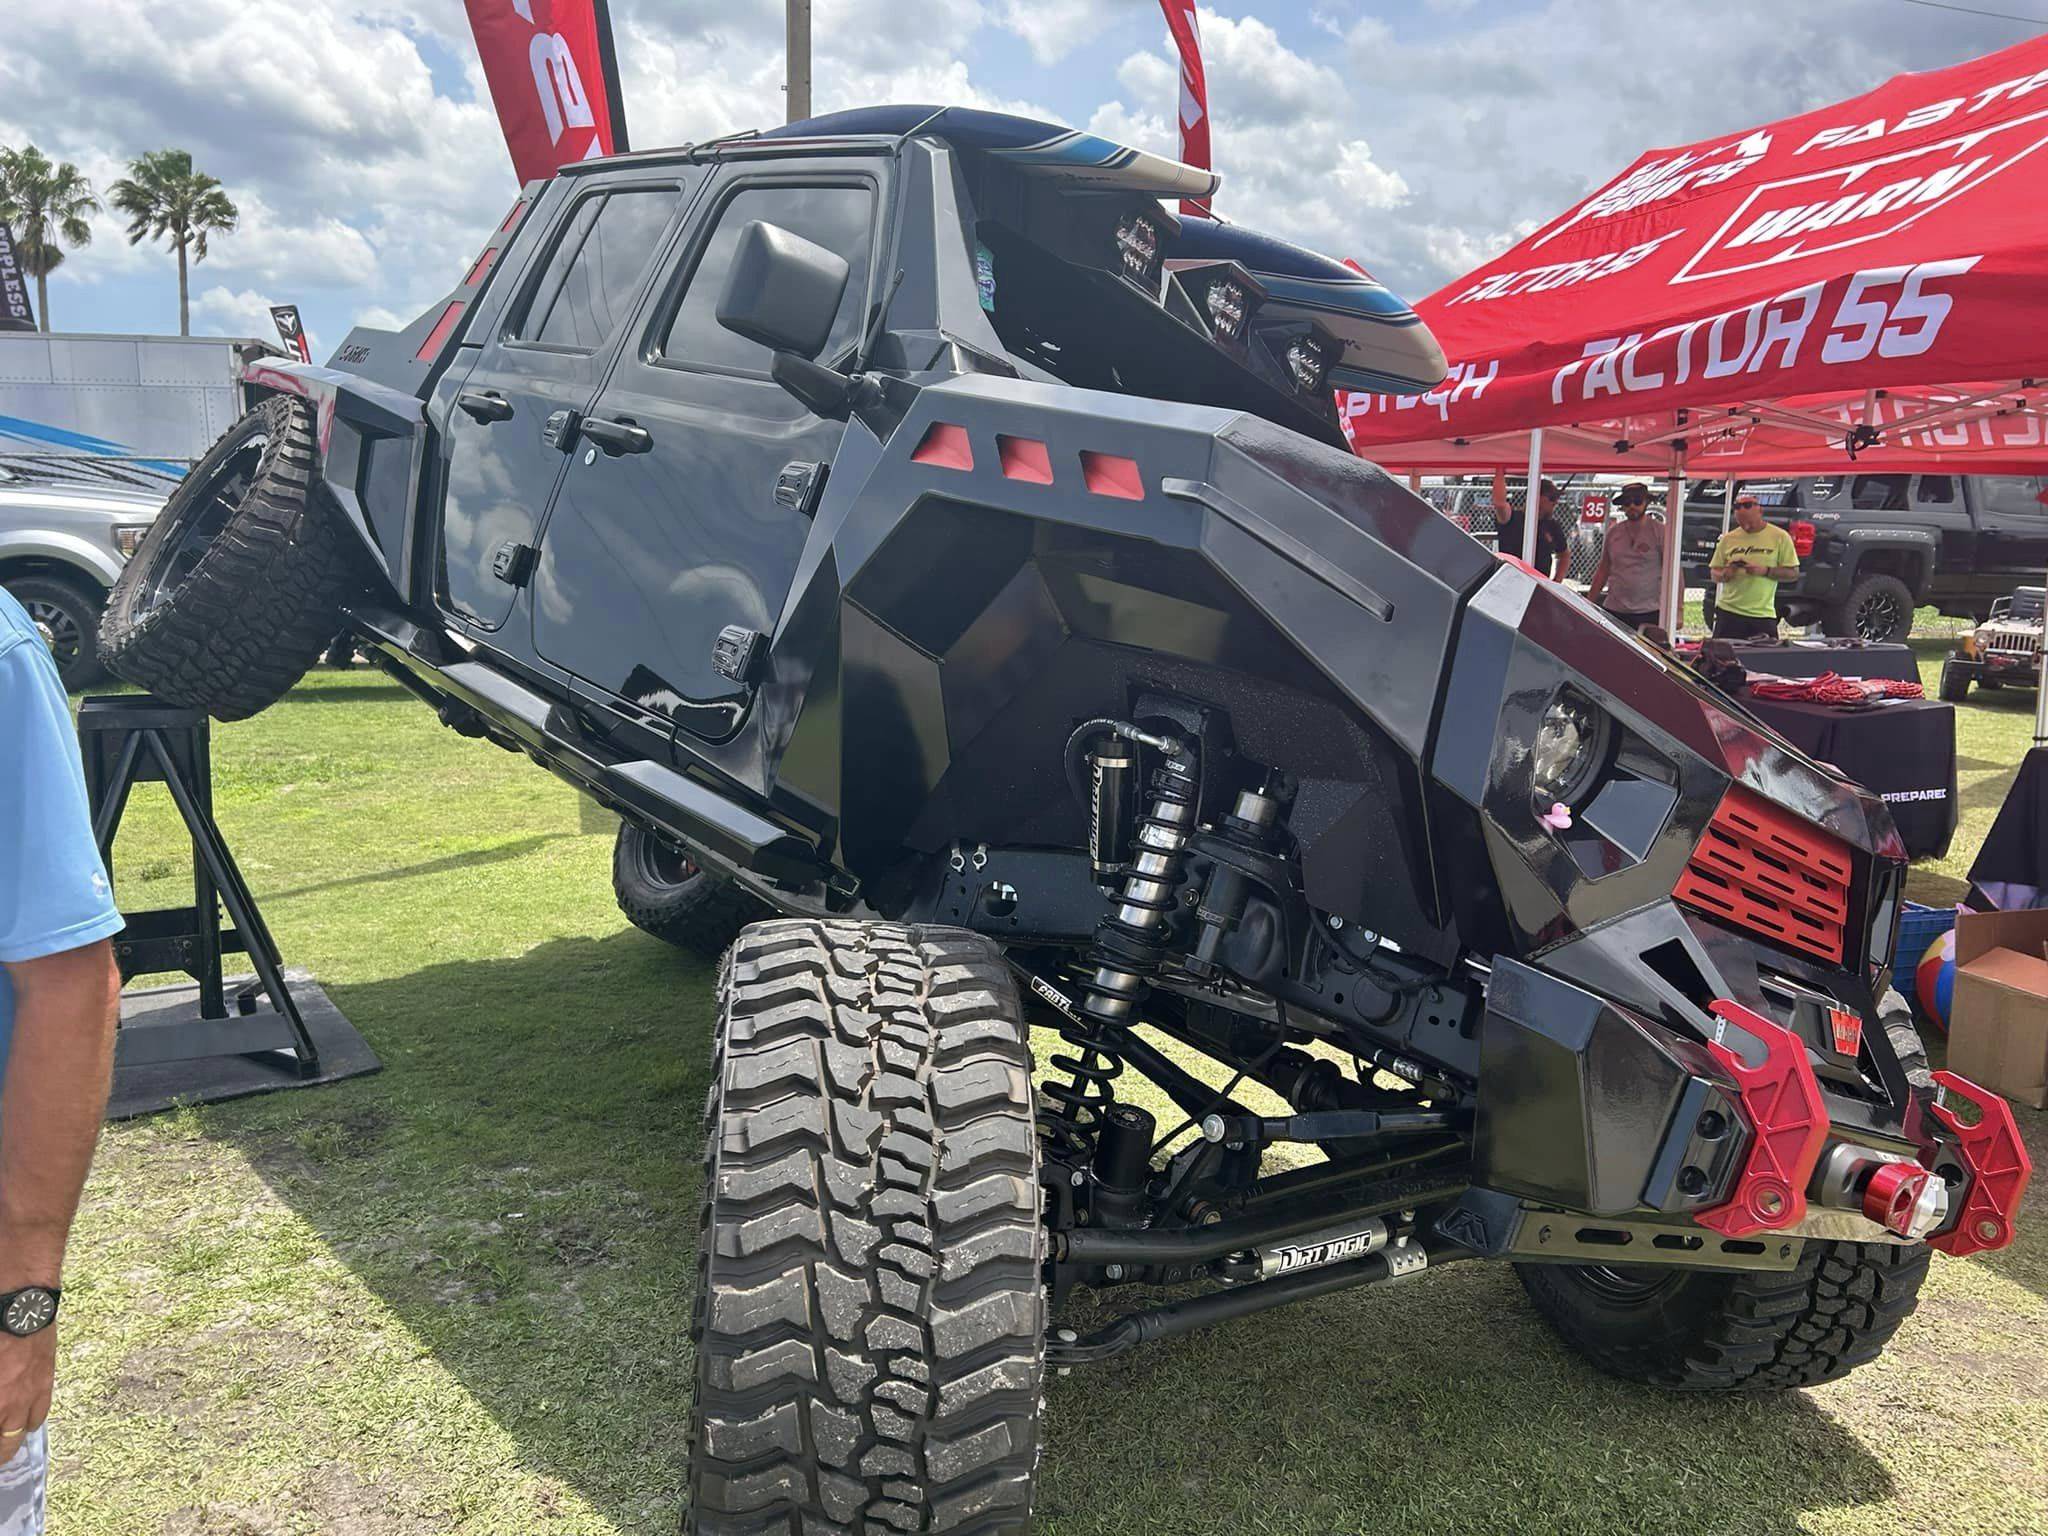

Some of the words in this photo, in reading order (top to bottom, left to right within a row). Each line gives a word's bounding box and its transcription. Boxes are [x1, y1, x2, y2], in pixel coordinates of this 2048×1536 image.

[1722, 154, 1994, 249] WARN
[1551, 280, 1828, 404] FACTOR
[1820, 254, 1985, 365] 55
[1585, 501, 1605, 518] 35
[1278, 1246, 1325, 1272] DIRT
[1324, 1233, 1371, 1263] LOGIC
